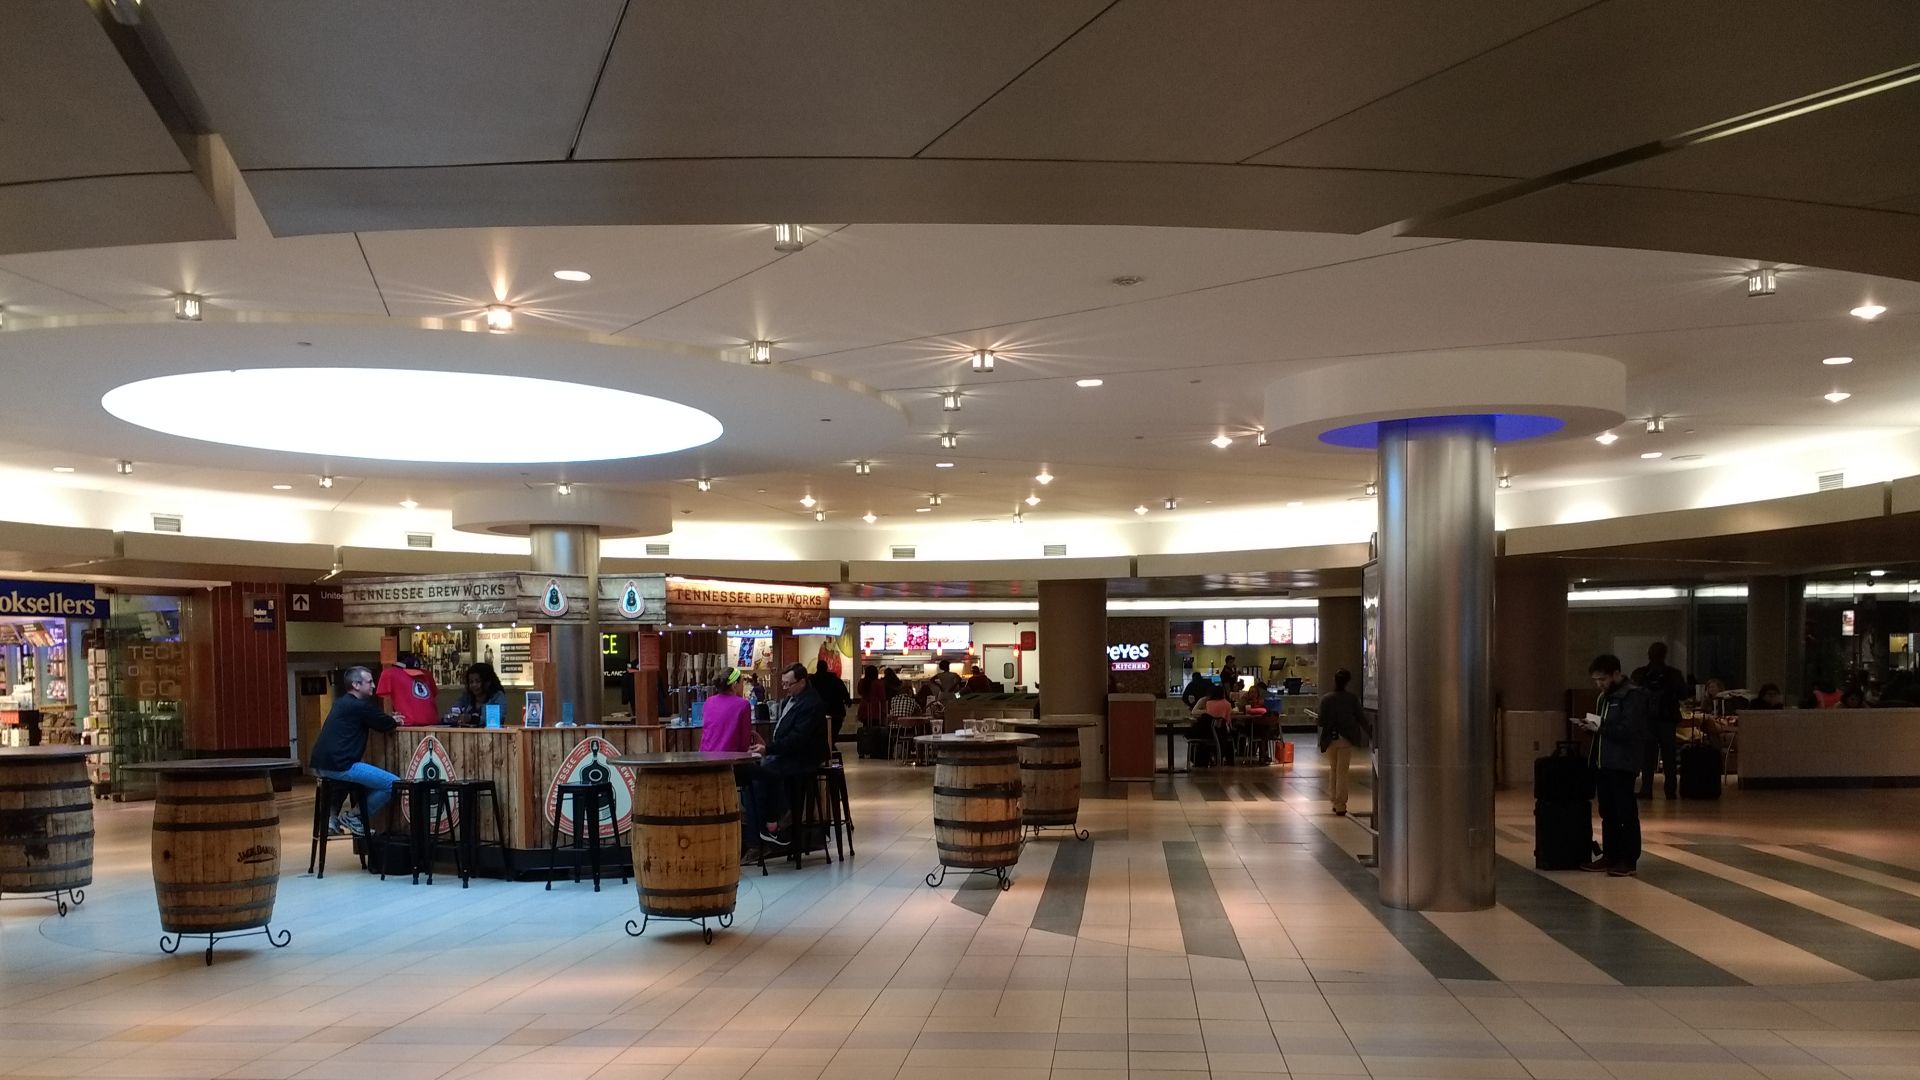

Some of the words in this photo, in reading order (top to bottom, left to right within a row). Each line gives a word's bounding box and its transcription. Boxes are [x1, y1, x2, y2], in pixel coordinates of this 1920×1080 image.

[352, 587, 424, 601] TENNESSEE
[428, 585, 460, 598] BREW
[463, 583, 505, 598] WORKS
[676, 588, 751, 604] TENNESSEE
[755, 592, 784, 604] BREW
[787, 593, 822, 606] WORKS
[128, 645, 184, 660] TECH
